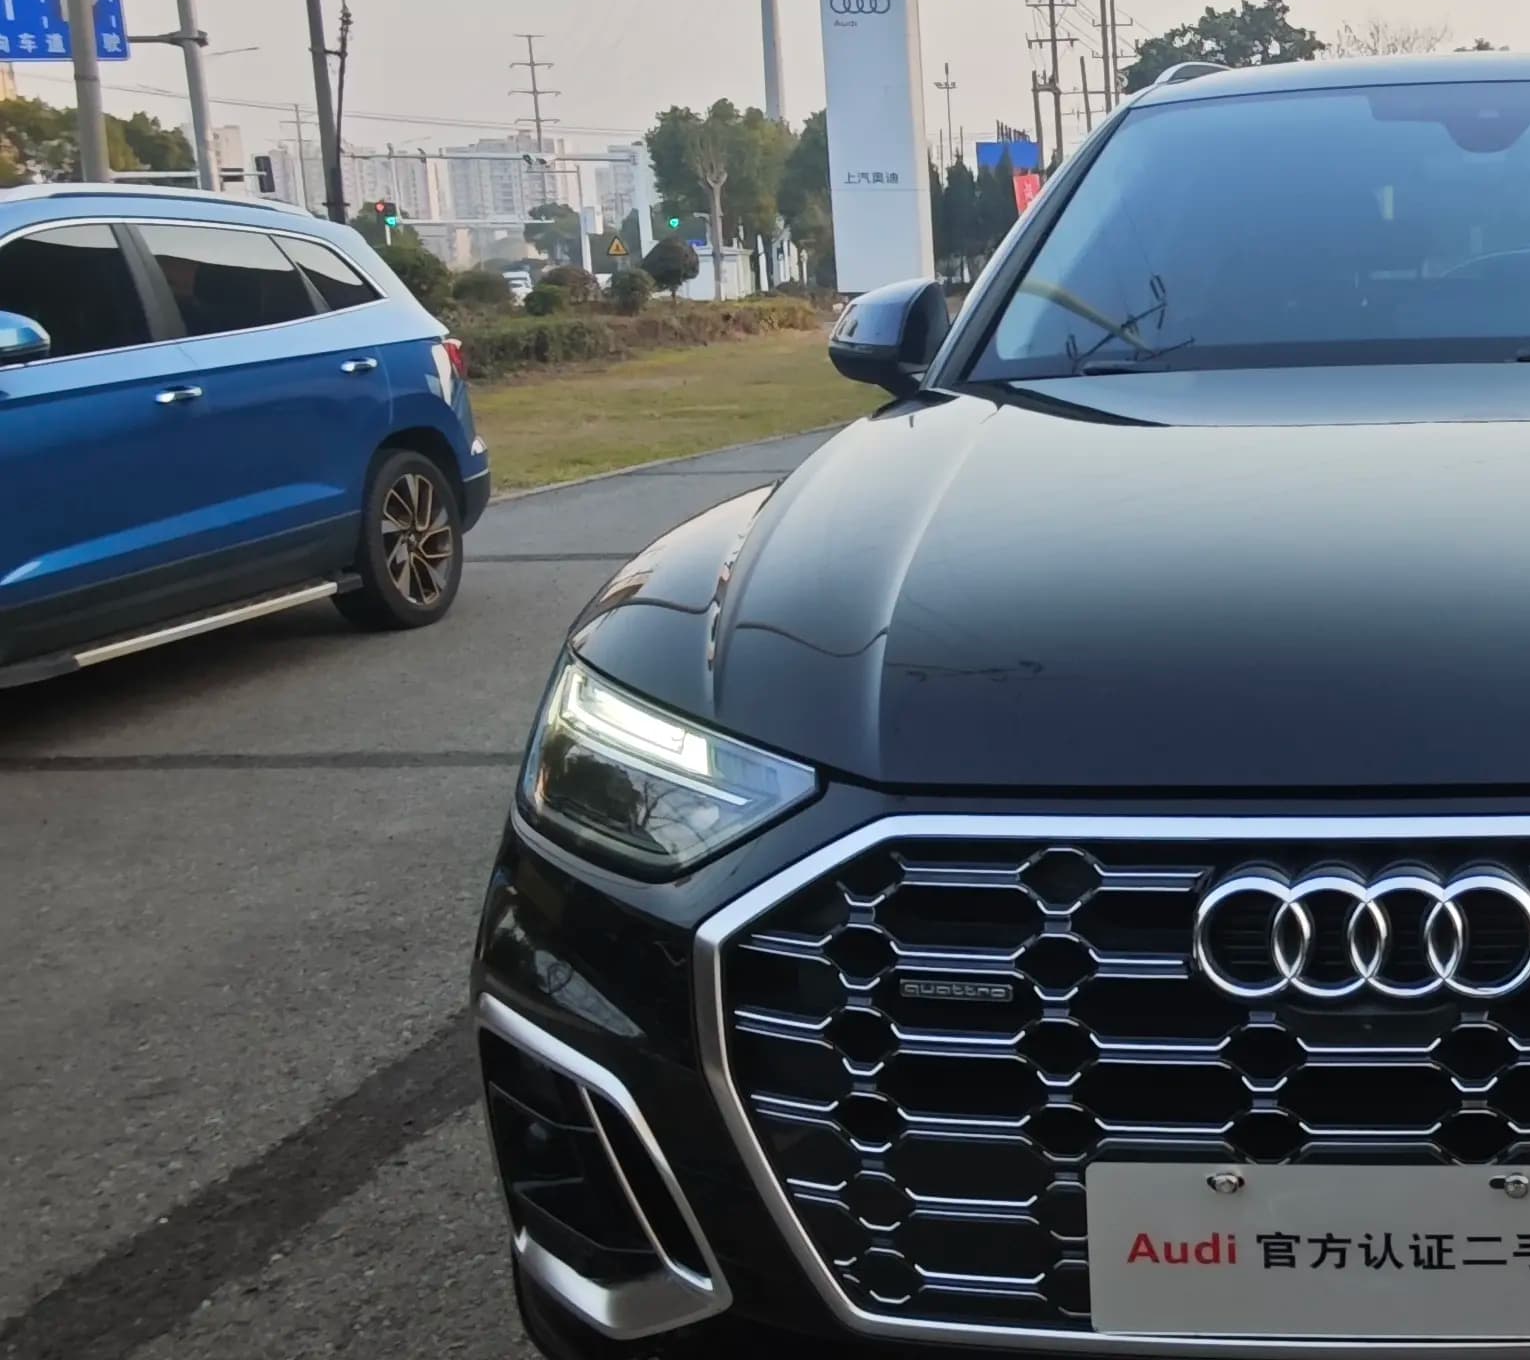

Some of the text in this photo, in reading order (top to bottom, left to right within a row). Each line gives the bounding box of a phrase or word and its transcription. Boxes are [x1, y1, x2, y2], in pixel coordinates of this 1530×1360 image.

[843, 171, 899, 184] 上汽奥迪
[902, 981, 1009, 1000] quattro
[1126, 1232, 1238, 1265] Audi
